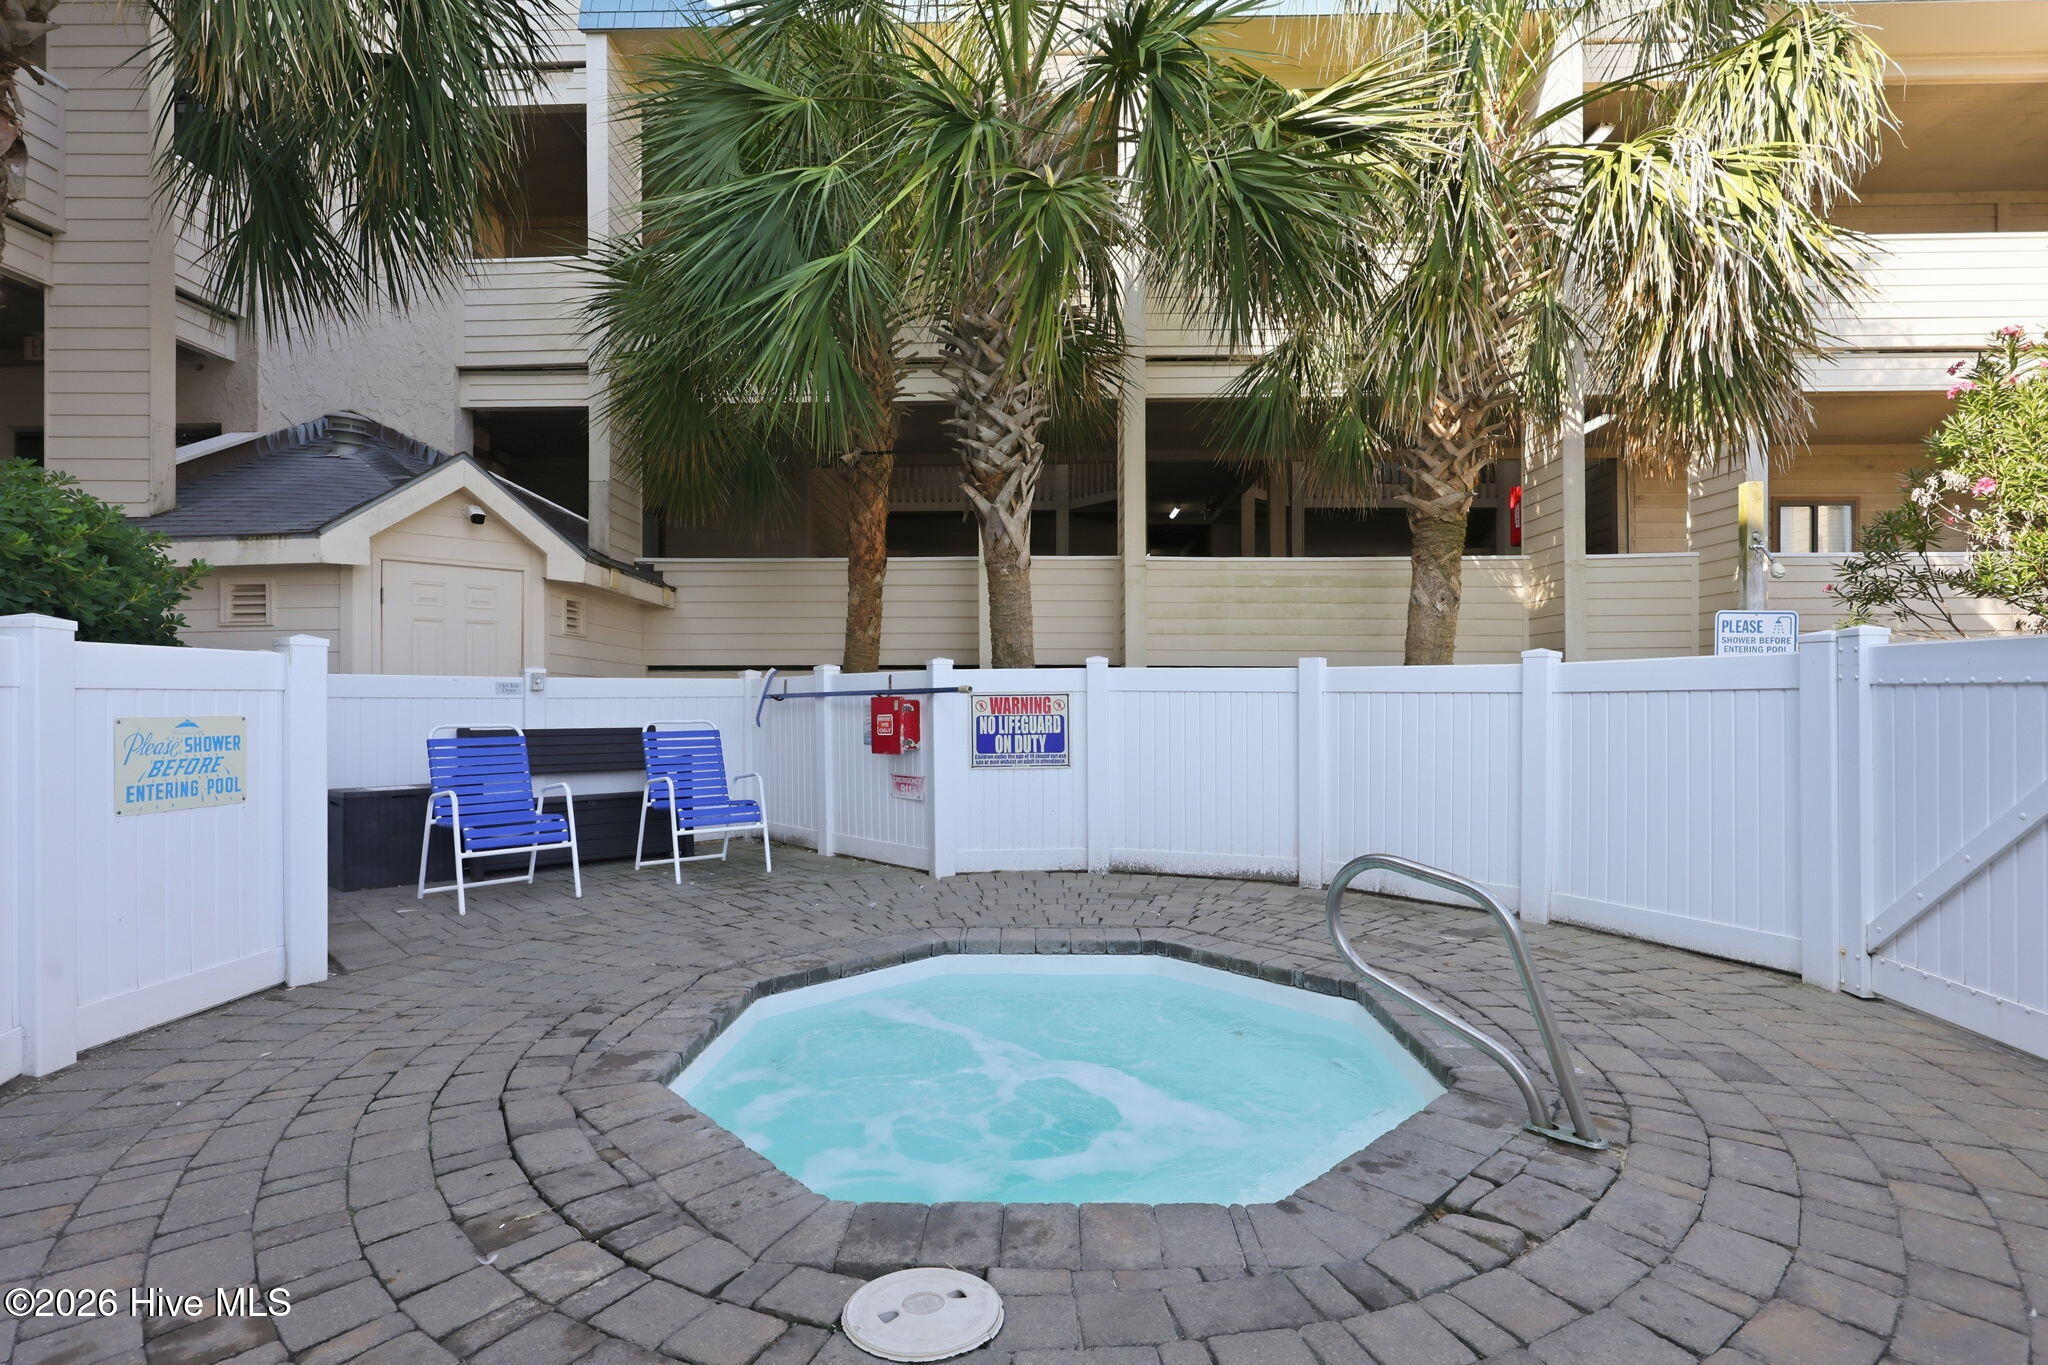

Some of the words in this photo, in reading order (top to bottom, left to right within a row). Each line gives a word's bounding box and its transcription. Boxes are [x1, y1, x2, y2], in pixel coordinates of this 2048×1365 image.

[1721, 619, 1764, 634] PLEASE
[1721, 636, 1756, 645] SHOWER
[1759, 636, 1792, 645] BEFORE
[1723, 645, 1764, 653] ENTERING
[989, 696, 1052, 715] WARNING
[979, 715, 996, 735] NO
[998, 715, 1061, 734] LIFEGUARD
[123, 728, 180, 766] Please
[184, 734, 241, 753] SHOWER
[994, 734, 1012, 754] ON
[1014, 734, 1047, 753] DUTY
[147, 756, 224, 778] BEFORE
[125, 780, 199, 803] ENTERING
[207, 776, 241, 795] POOL
